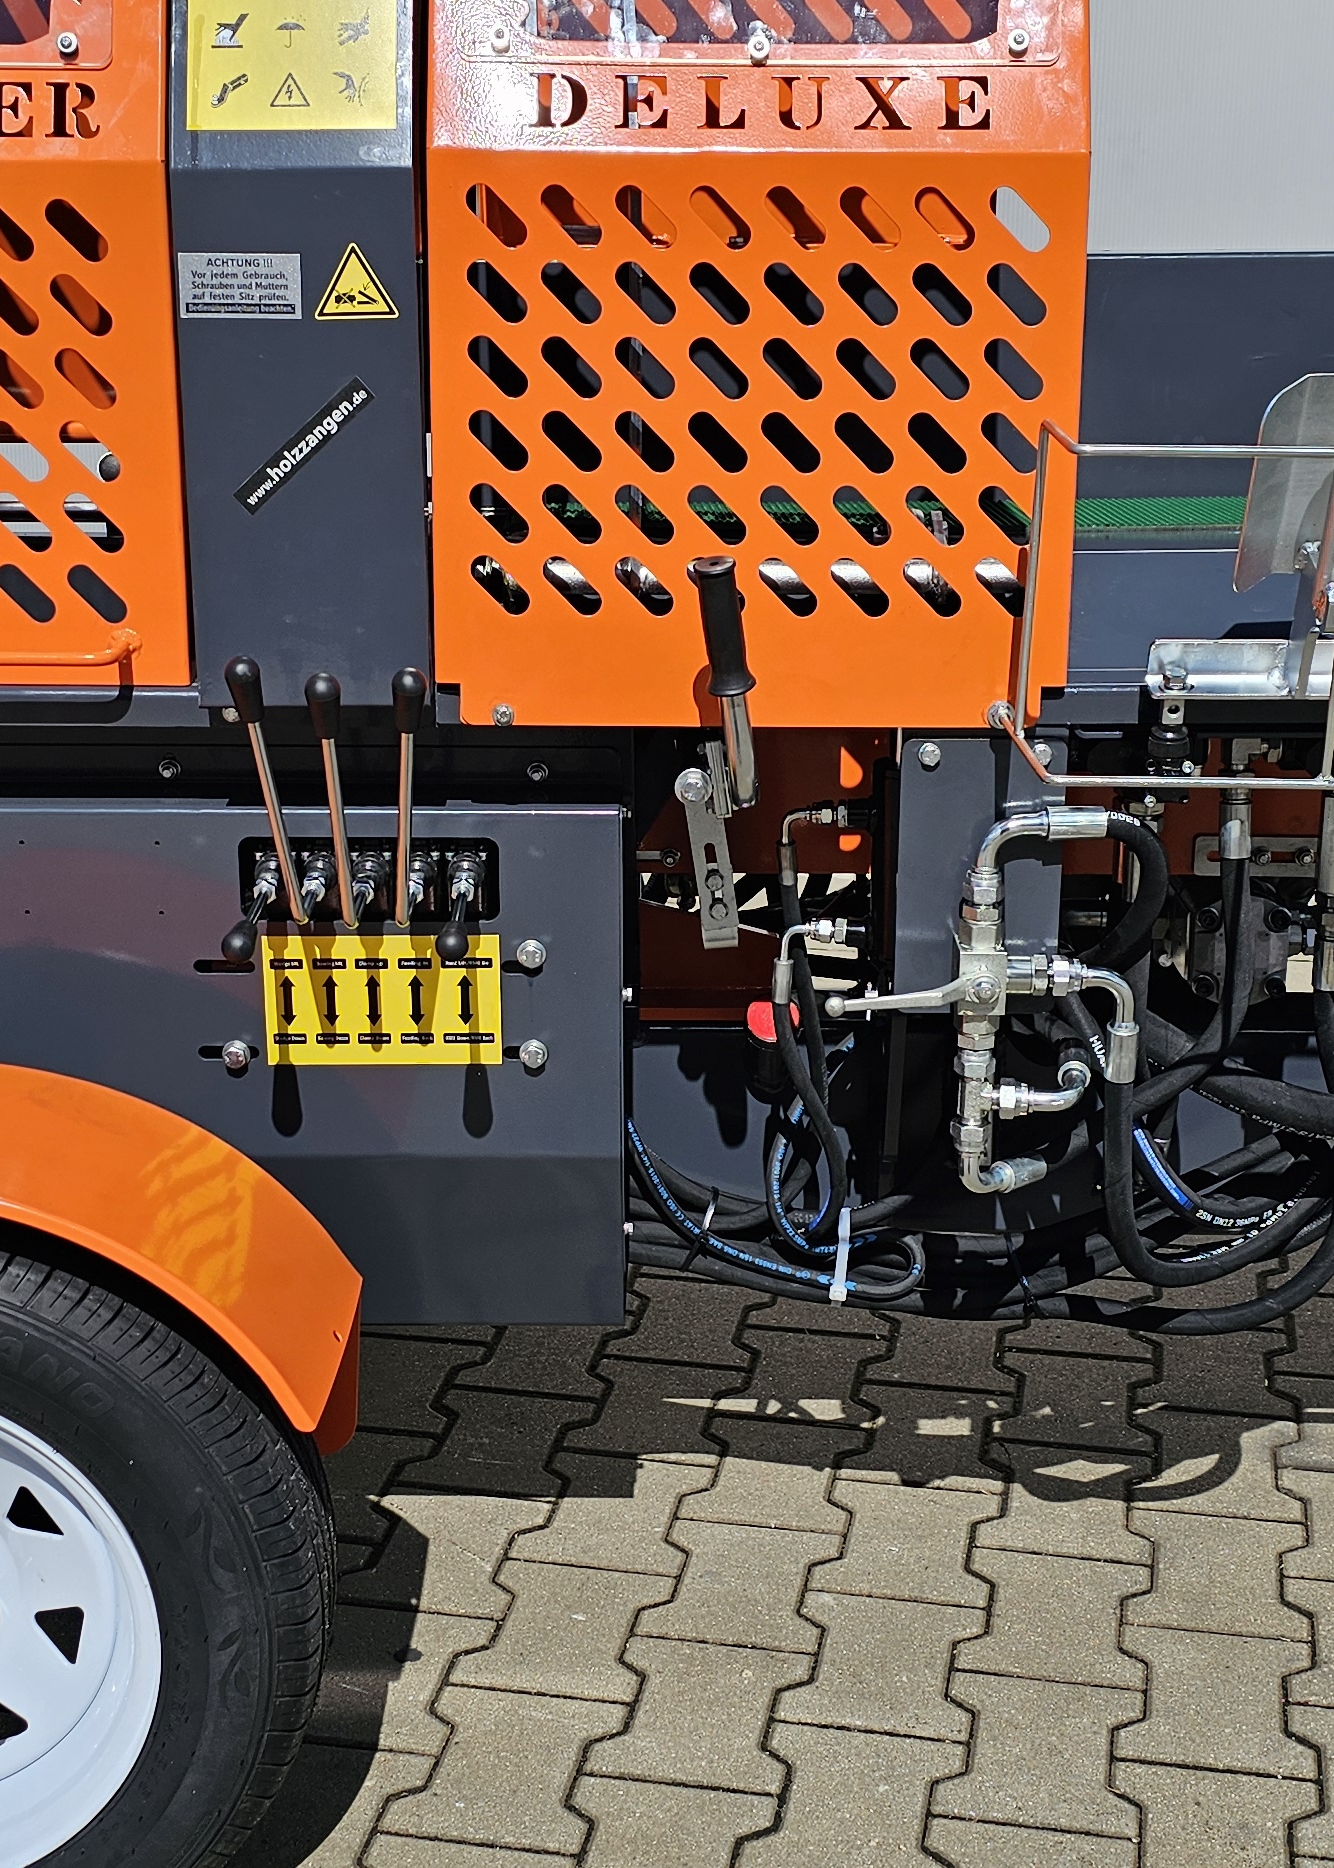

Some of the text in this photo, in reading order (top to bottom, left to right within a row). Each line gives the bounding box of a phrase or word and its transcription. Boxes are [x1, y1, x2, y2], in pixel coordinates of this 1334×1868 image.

[528, 72, 991, 131] DELUXE
[206, 258, 260, 268] ACHTUNG
[191, 270, 288, 281] Vor jedem Gebrauch,
[191, 281, 289, 290] Schrauben und Muttern
[191, 291, 289, 303] auf festen Sitz prüfen.
[188, 304, 260, 314] Bedienungsanleitung
[246, 389, 368, 506] www.holzzangen.de
